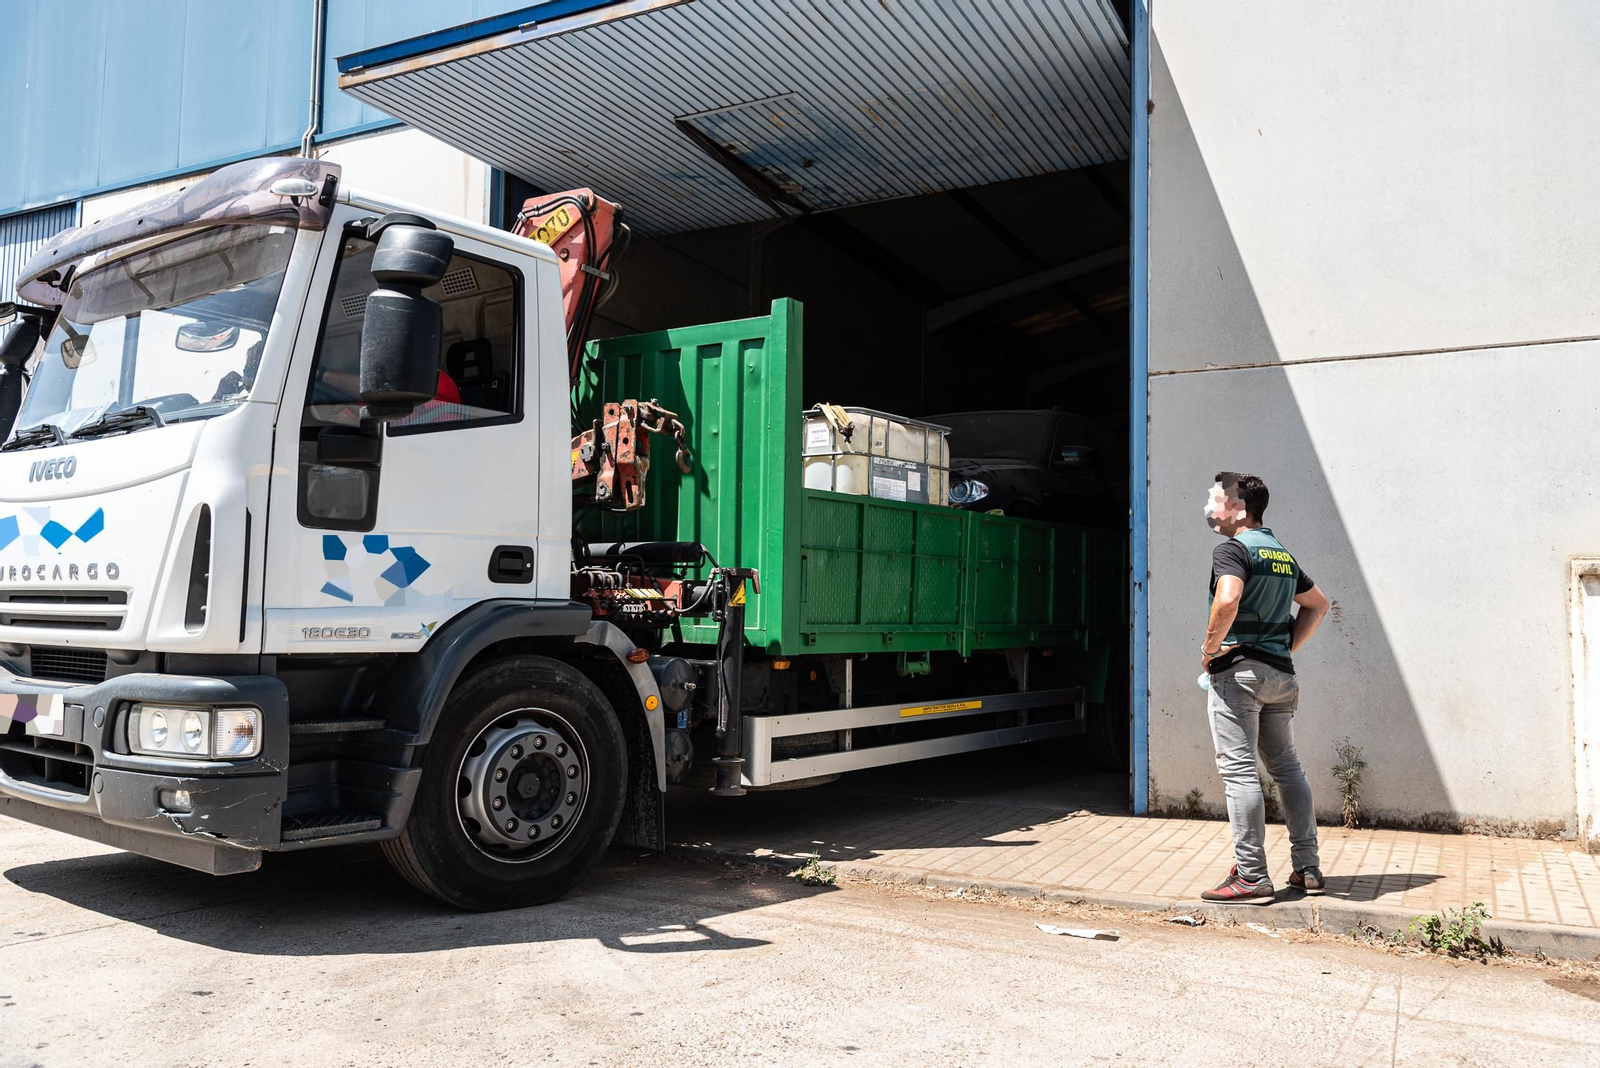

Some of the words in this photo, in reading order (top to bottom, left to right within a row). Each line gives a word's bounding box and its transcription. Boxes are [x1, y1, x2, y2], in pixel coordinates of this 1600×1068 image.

[29, 455, 77, 483] IVECO
[1258, 549, 1295, 564] GUARDI
[1272, 562, 1293, 575] CIVIL
[301, 626, 371, 640] 180E30
